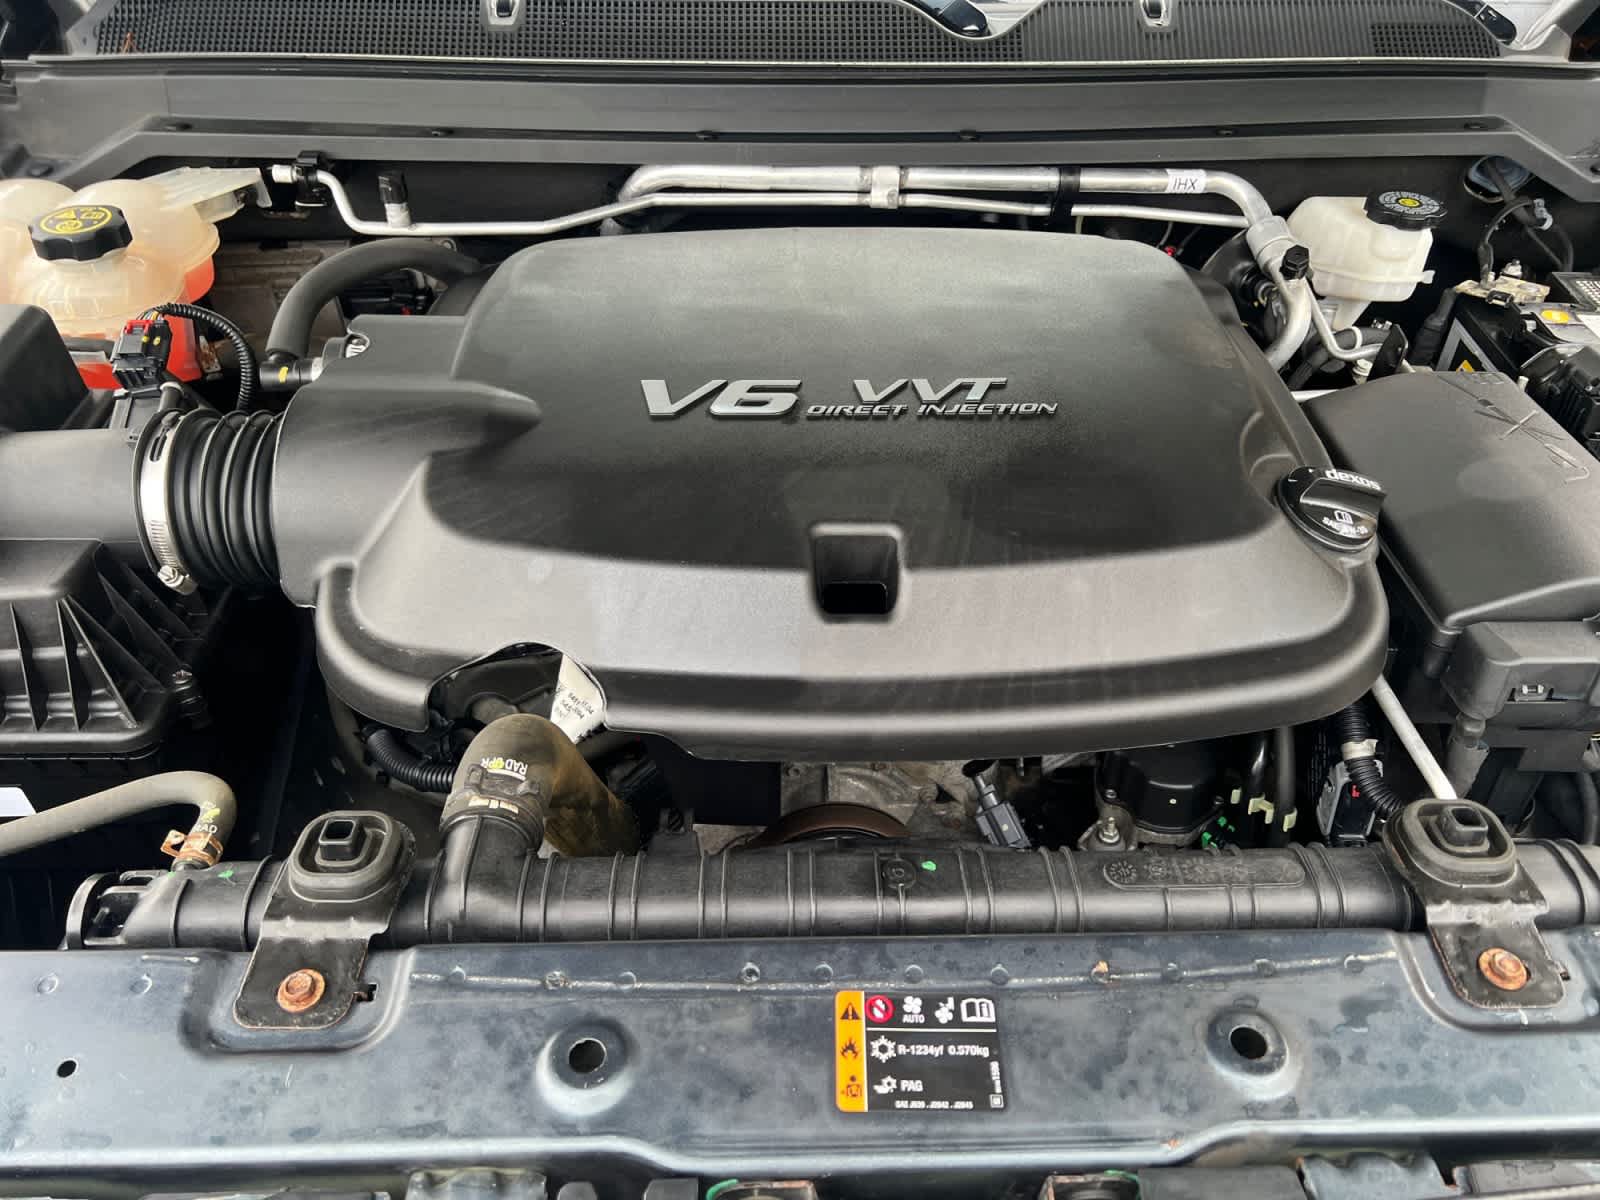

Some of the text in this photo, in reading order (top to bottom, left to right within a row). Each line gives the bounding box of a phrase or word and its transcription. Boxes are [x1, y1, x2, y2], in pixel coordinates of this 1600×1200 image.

[641, 379, 801, 418] V6
[853, 377, 1008, 404] VVT
[806, 402, 1059, 418] DIRECT INJECTION
[1325, 468, 1382, 491] dexos
[505, 759, 528, 775] RAD
[902, 1014, 925, 1024] AUTO
[897, 1044, 990, 1058] R-1234yf 0.570kg
[900, 1079, 924, 1092] PAG
